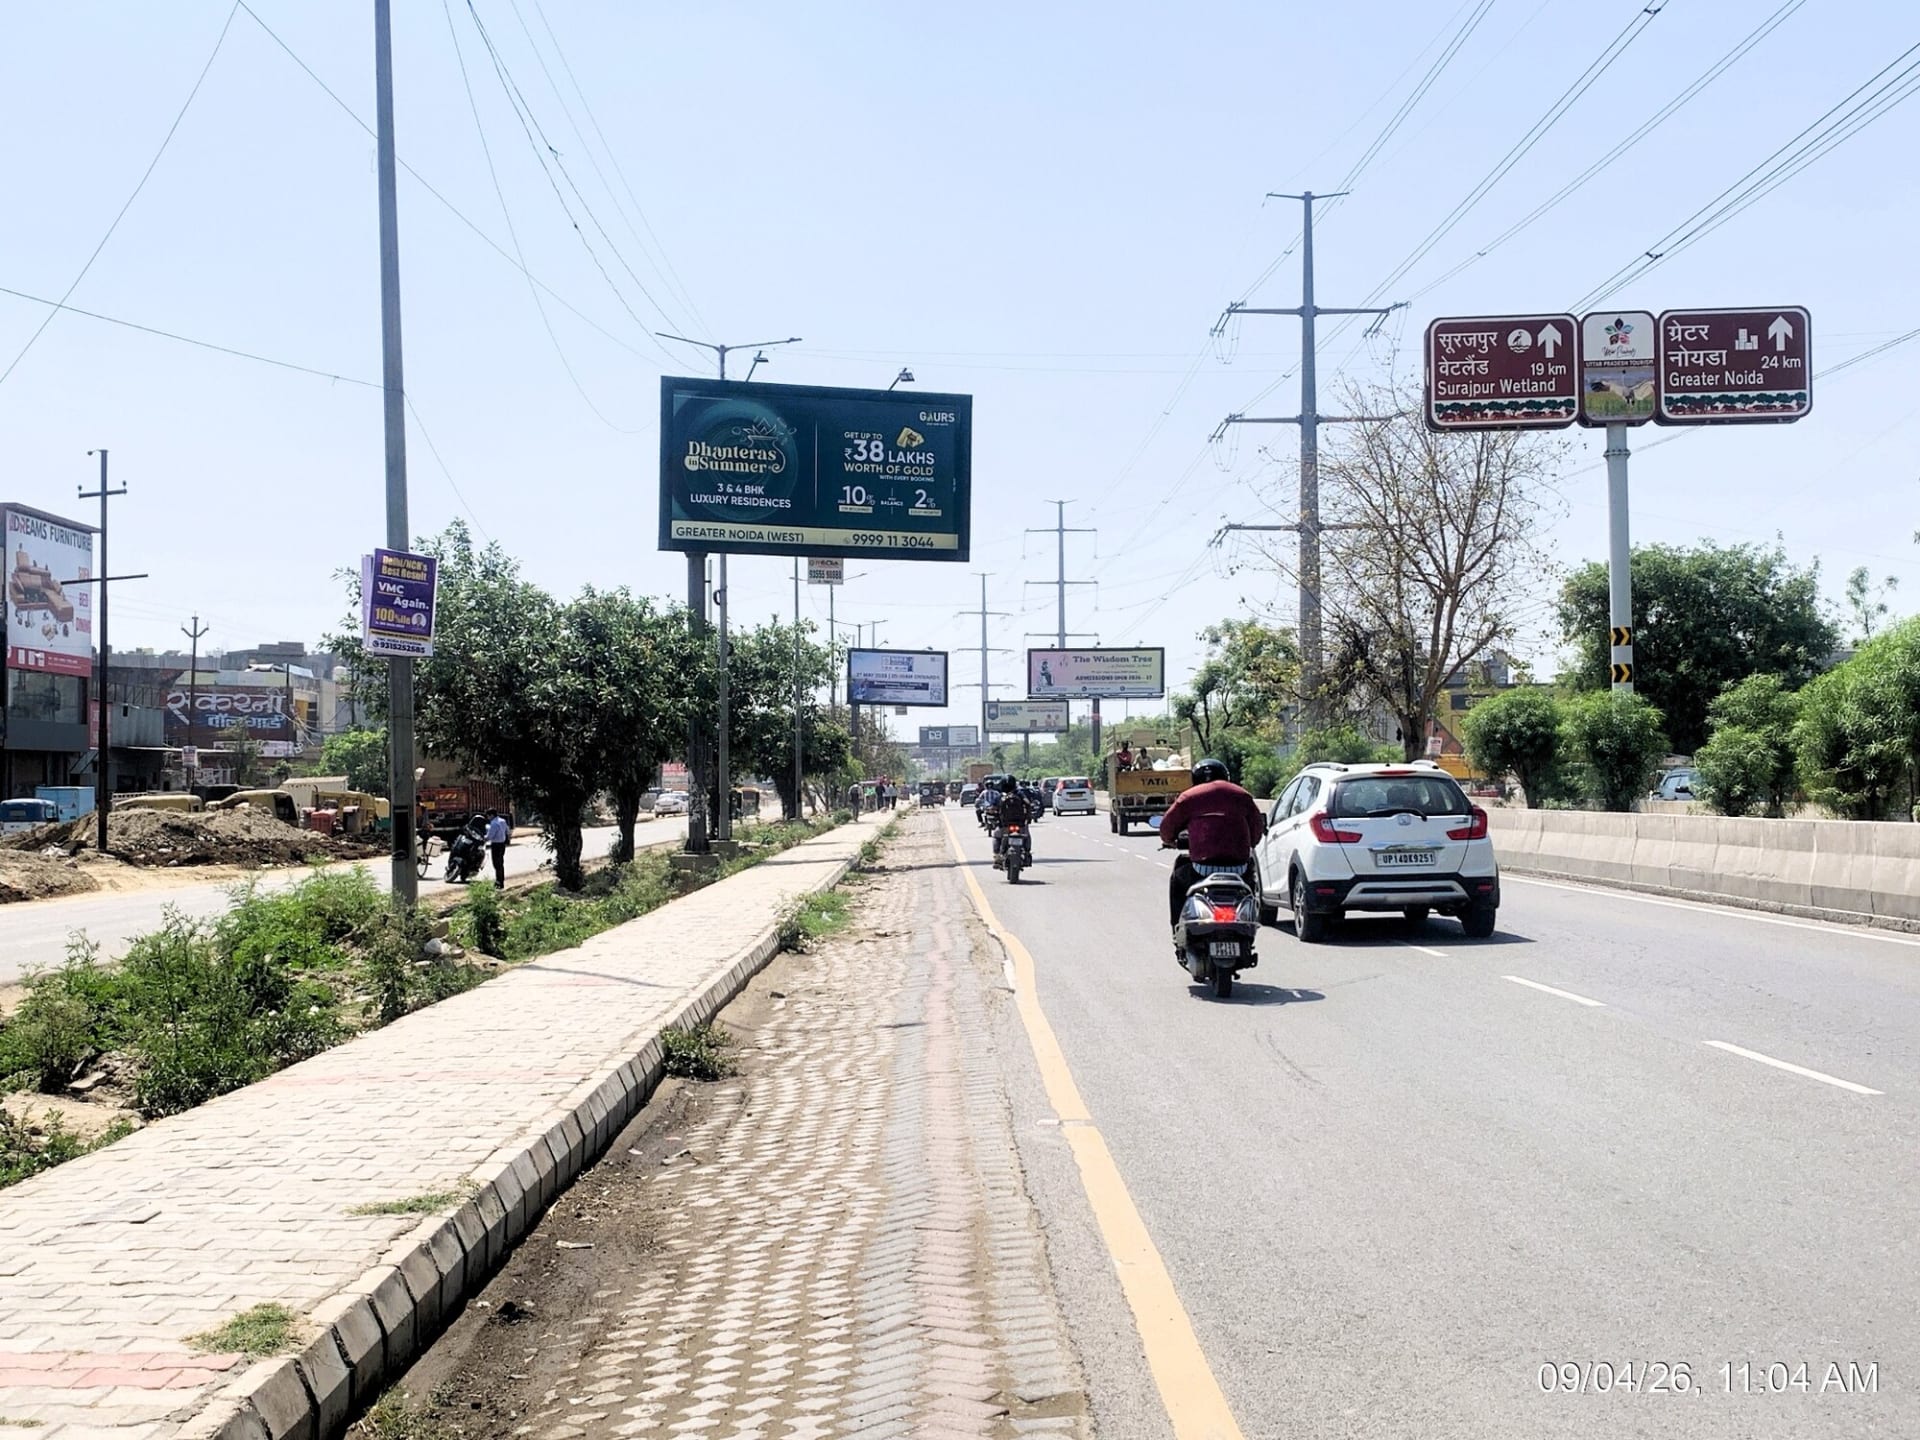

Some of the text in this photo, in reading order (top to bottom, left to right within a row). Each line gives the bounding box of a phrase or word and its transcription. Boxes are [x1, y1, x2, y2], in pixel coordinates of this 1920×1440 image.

[1667, 319, 1710, 342] ग्रेटर
[1438, 332, 1498, 354] सूरजपुर
[1667, 344, 1727, 367] नोयडा
[1761, 355, 1801, 369] 24 km
[1438, 354, 1489, 376] वेटलैंड
[1531, 362, 1566, 376] 19 km
[1669, 370, 1764, 387] Greater Noida
[1438, 378, 1556, 397] Surajpur Wetland
[919, 411, 955, 423] GAURS
[844, 431, 859, 440] GET
[861, 432, 871, 440] UP
[688, 441, 777, 461] Dhanteras
[888, 449, 935, 465] LAKHS
[699, 456, 767, 474] Summer
[844, 463, 883, 474] WORTH
[886, 465, 901, 475] OF
[717, 483, 765, 495] 3 & 4 BHK
[690, 494, 792, 509] LUXURY RESIDENCES
[49, 526, 91, 552] FURNITURE
[676, 526, 804, 543] GREATER NOIDA (WEST)
[852, 534, 935, 547] 9999 11 3044
[378, 581, 404, 594] VMC
[393, 597, 429, 610] Again.
[1132, 655, 1153, 663] Tree
